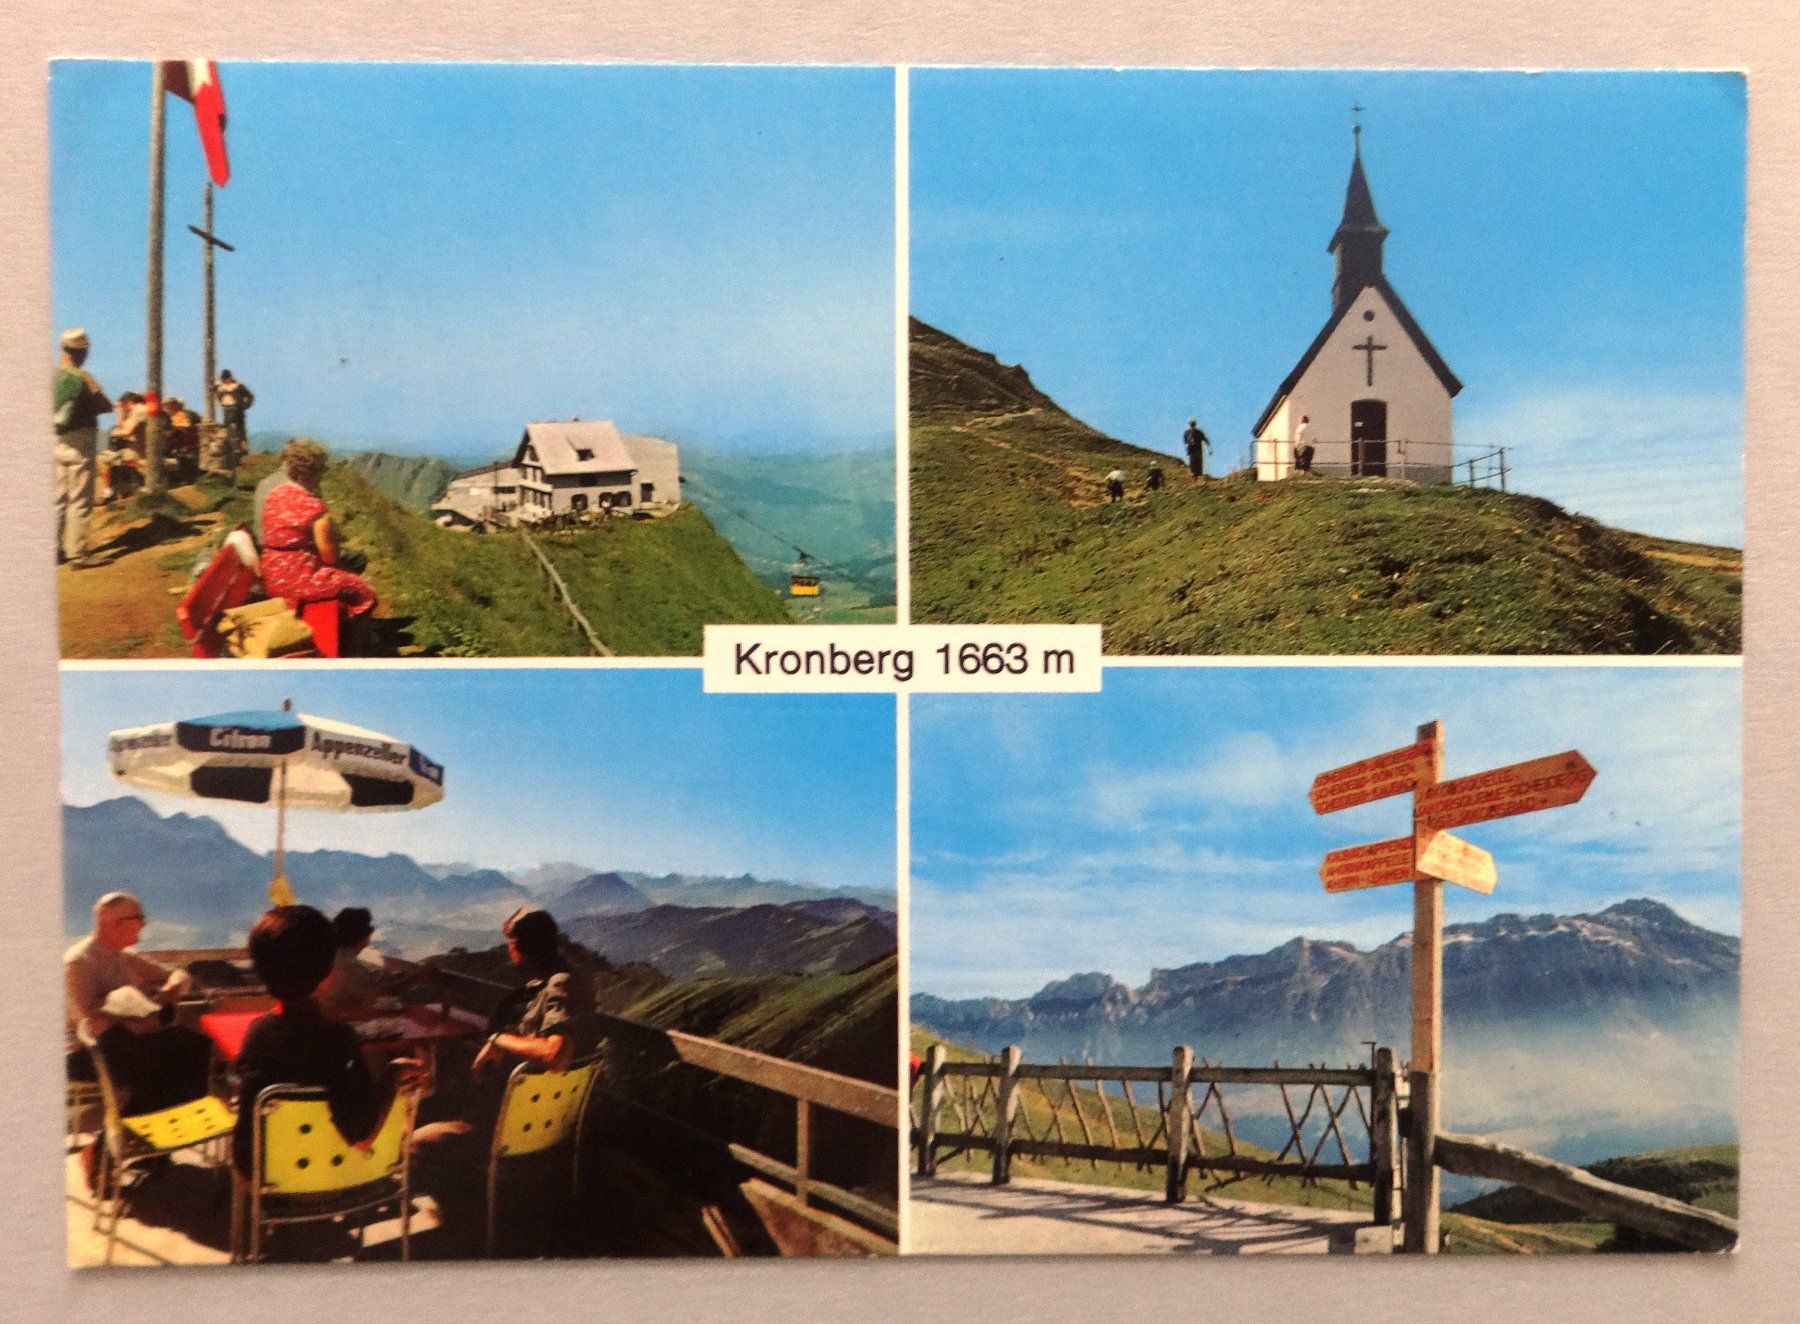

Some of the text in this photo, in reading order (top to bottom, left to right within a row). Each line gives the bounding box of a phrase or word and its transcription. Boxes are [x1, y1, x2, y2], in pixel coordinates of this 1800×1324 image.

[735, 642, 1075, 682] Kronberg 1663 m
